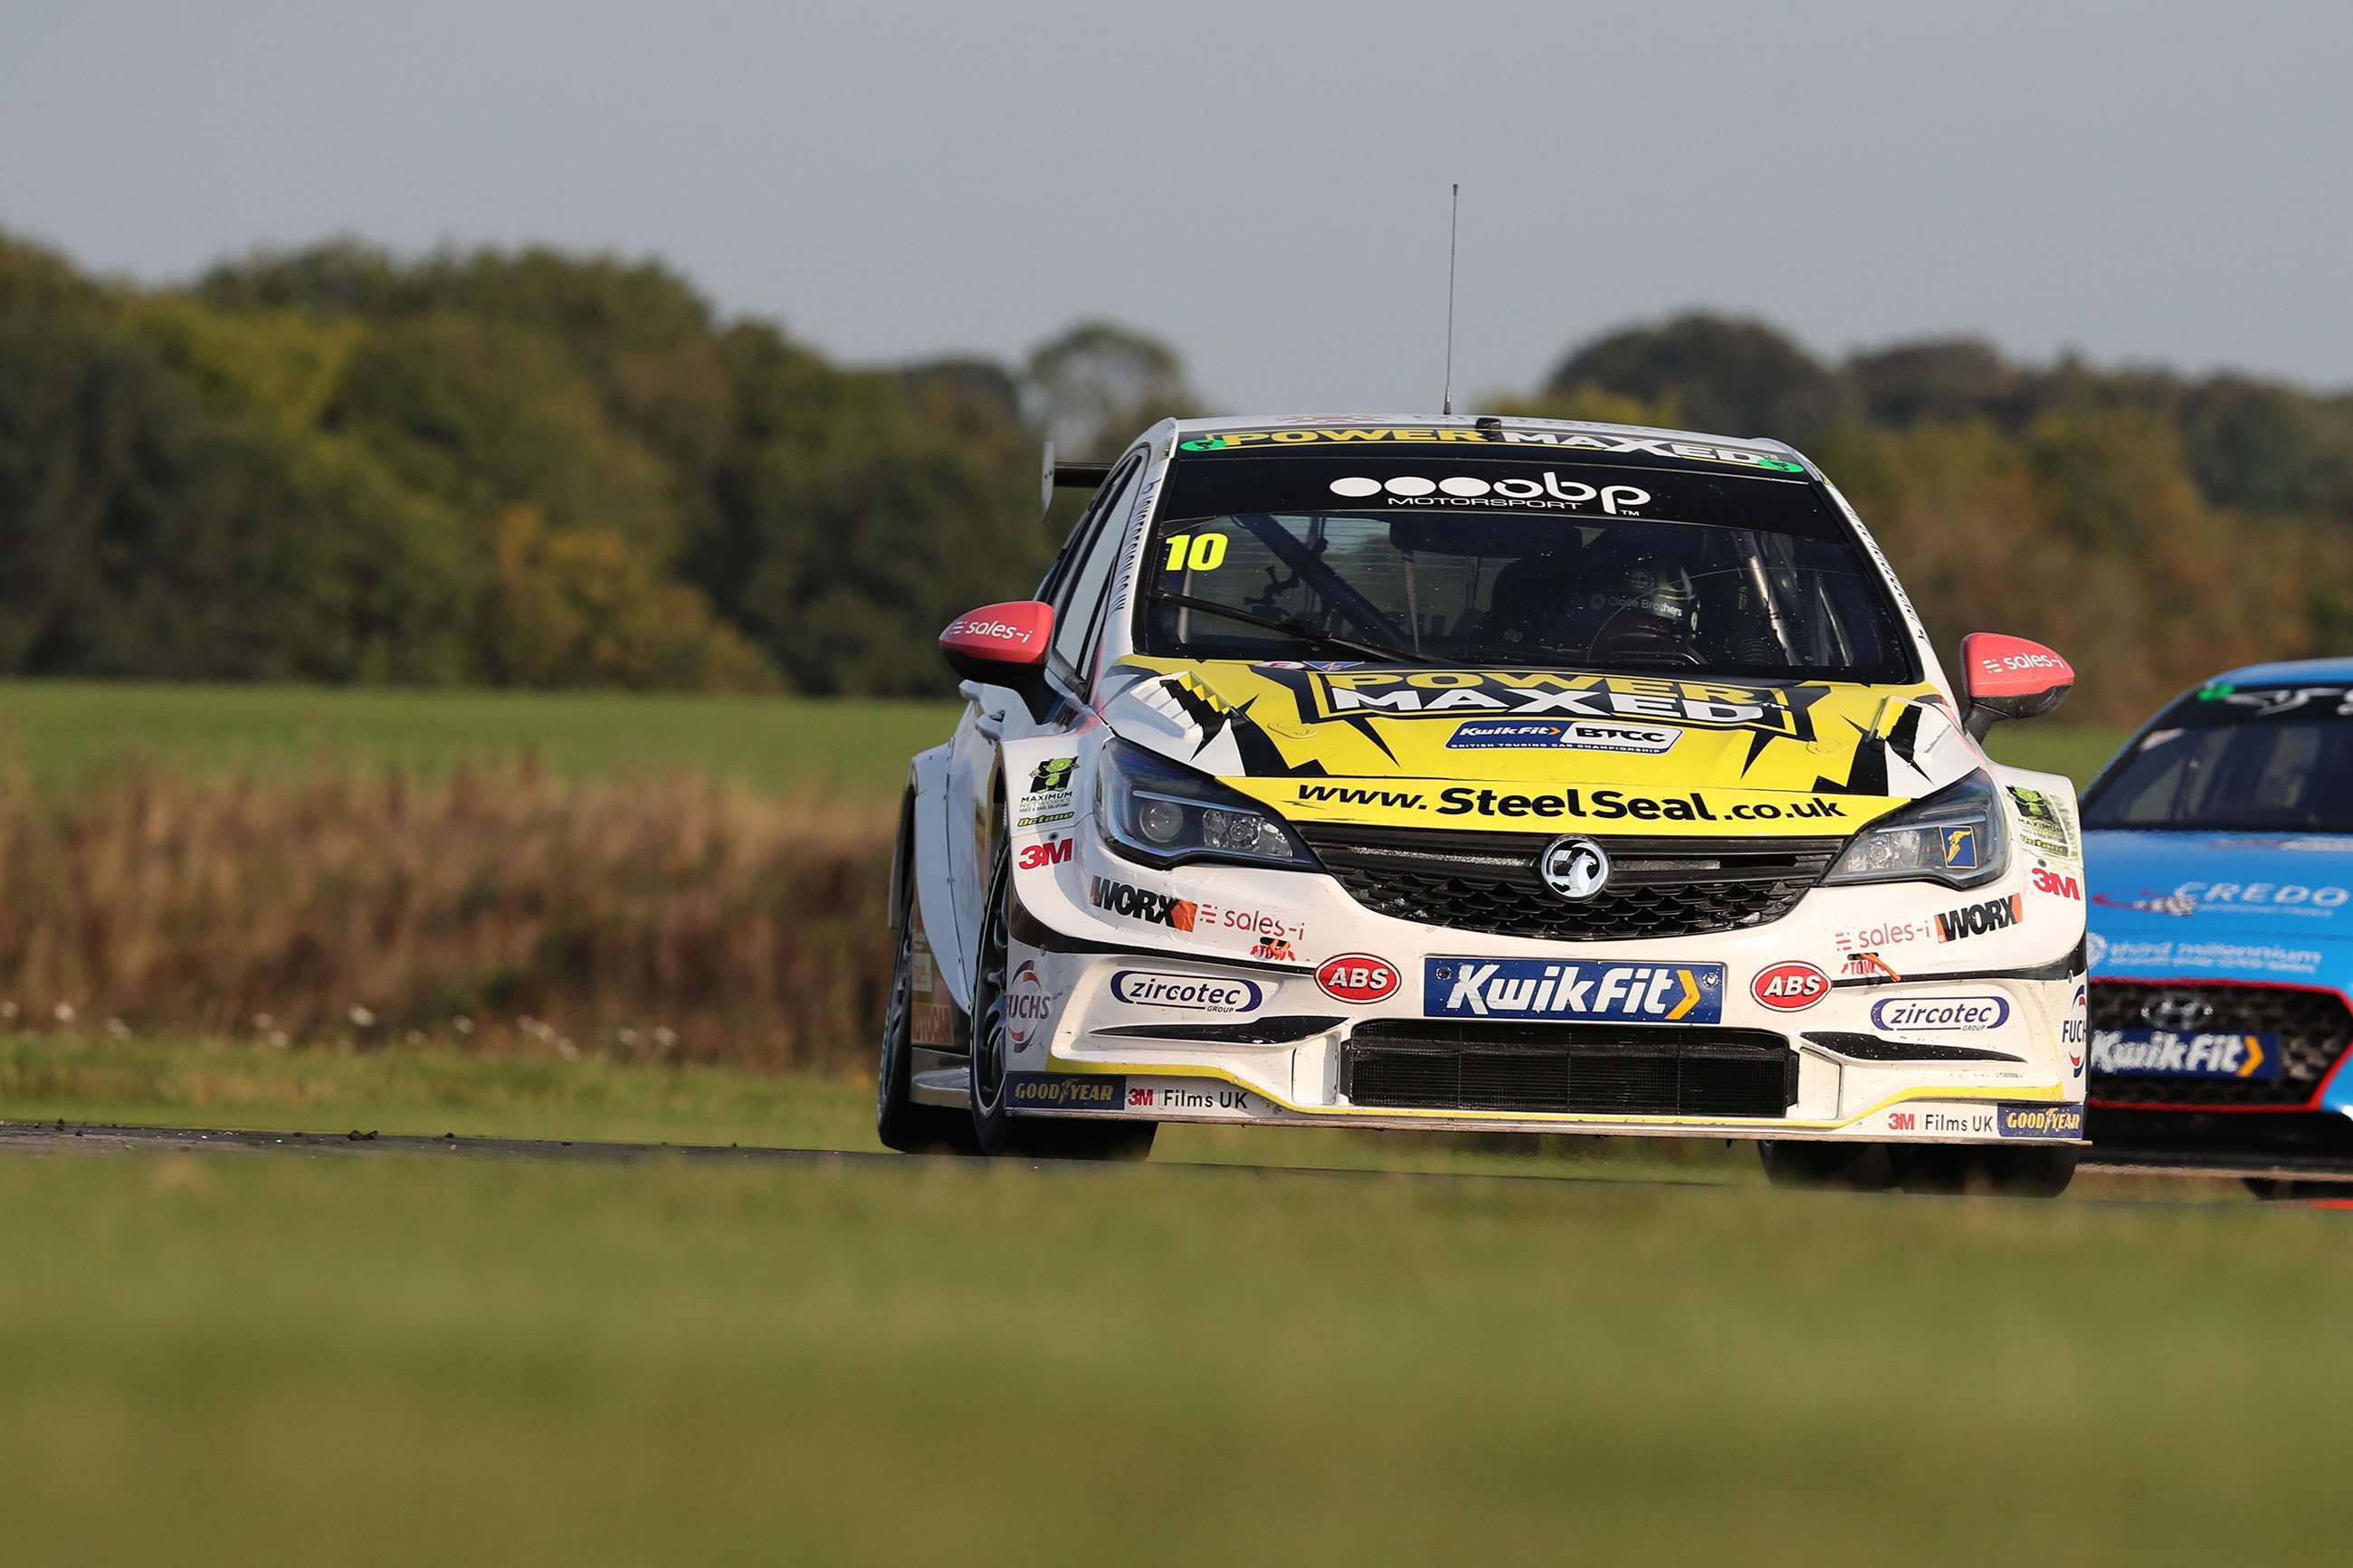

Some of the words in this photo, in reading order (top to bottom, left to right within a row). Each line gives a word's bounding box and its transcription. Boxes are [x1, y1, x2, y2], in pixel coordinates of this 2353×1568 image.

[1222, 429, 1487, 446] POWER
[1501, 432, 1764, 462] MAXED
[1387, 497, 1582, 510] MOTORSPORT
[1165, 532, 1229, 571] 10
[965, 620, 1034, 643] sales-i
[2003, 651, 2064, 670] sales-i
[1325, 672, 1764, 704] POWER
[1331, 688, 1764, 722] MAXED
[1575, 727, 1666, 743] BTCC
[1577, 745, 1661, 754] CHAMPIONSHIP
[1020, 791, 1073, 803] MAXIMUM
[1018, 838, 1073, 870] 3M
[2031, 867, 2081, 901] 3M
[2175, 881, 2349, 907] CREDO
[1095, 875, 1180, 929] WORX
[1223, 908, 1305, 941] sales-i
[1939, 894, 2016, 942] WORX
[1858, 919, 1930, 948] sales-i
[1327, 966, 1389, 990] ABS
[1446, 963, 1675, 1015] KwikFit
[1764, 974, 1821, 997] ABS
[1129, 978, 1242, 1005] zircotec
[1007, 994, 1051, 1020] UCHS
[1206, 1005, 1234, 1014] GROUP
[1890, 1003, 1993, 1024] zircotec
[1128, 1088, 1154, 1106] 3M
[1164, 1088, 1214, 1107] Films
[1219, 1090, 1249, 1109] UK
[1888, 1113, 1915, 1130] 3M
[1925, 1114, 1968, 1131] Films
[1972, 1115, 1994, 1132] UK
